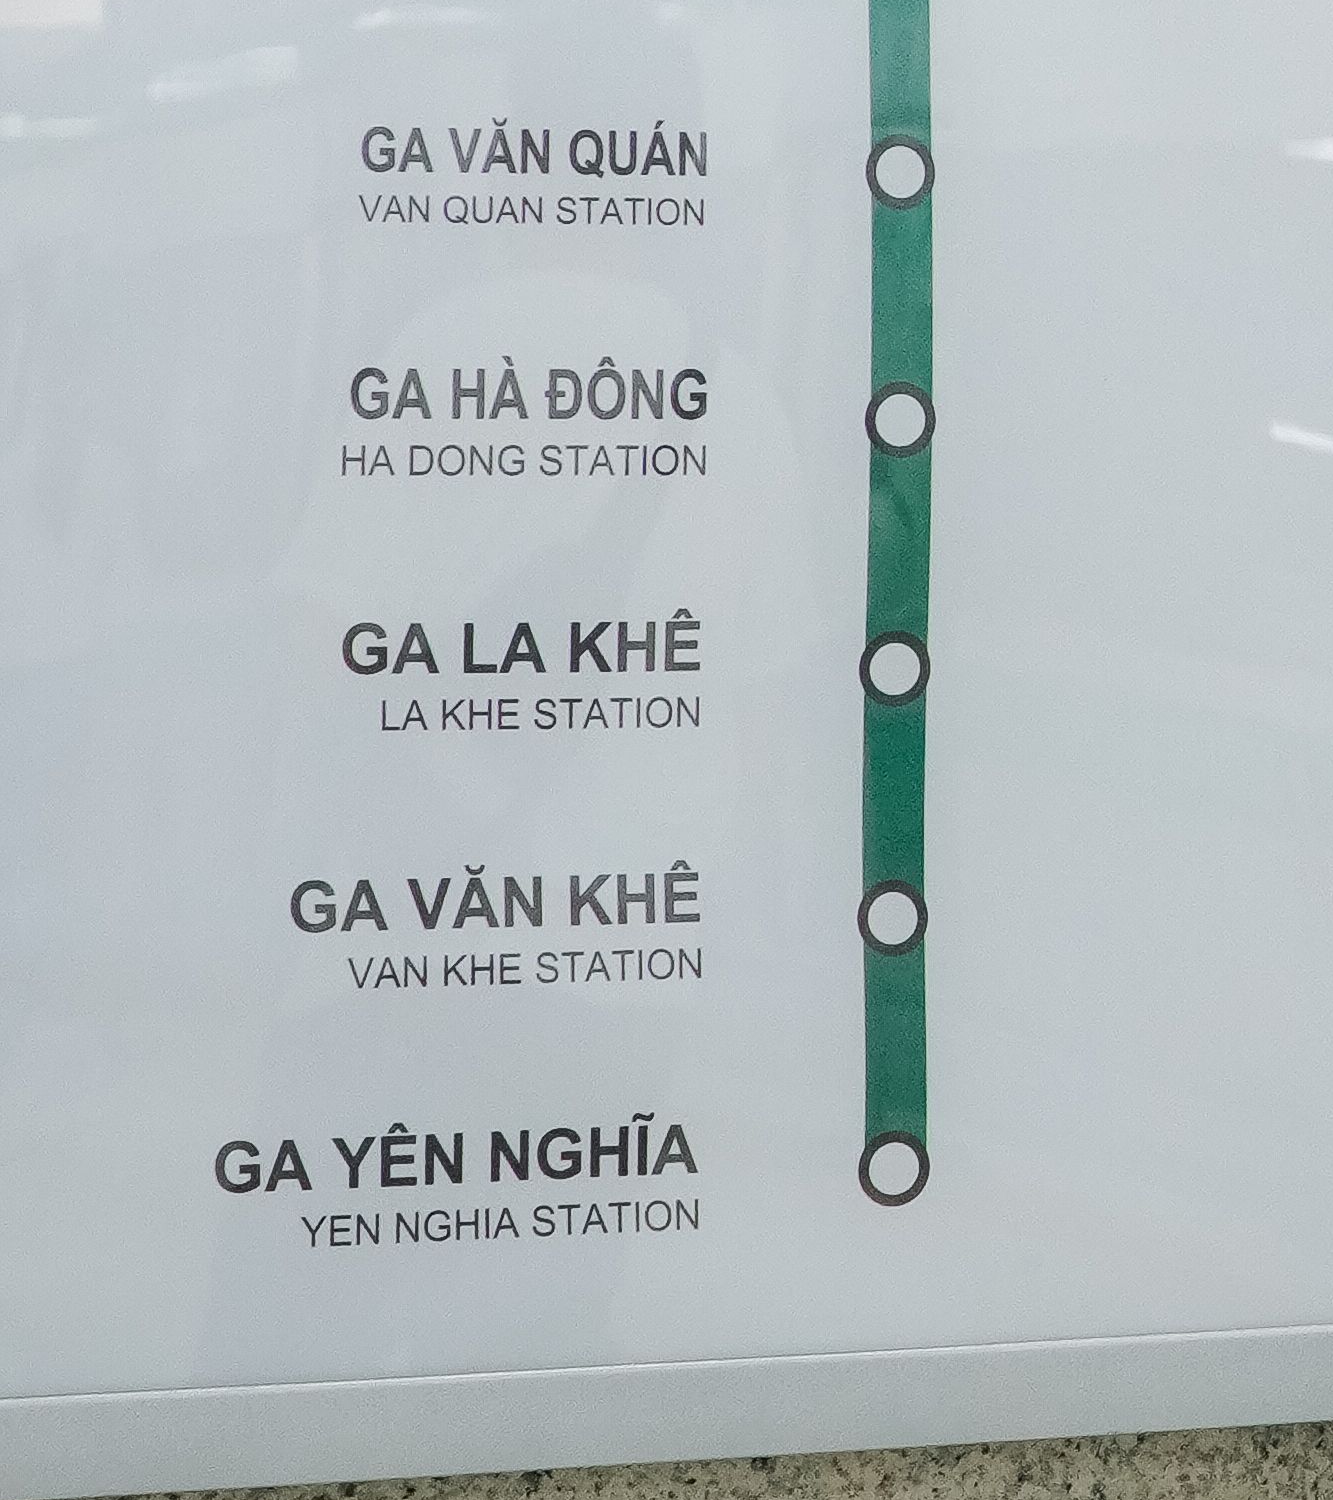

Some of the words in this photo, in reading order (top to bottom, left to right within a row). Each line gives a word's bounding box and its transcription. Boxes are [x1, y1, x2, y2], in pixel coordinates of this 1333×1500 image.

[362, 127, 433, 172] GA
[449, 118, 550, 174] VĂN
[569, 120, 706, 178] QUÁN
[359, 195, 429, 222] VAN
[444, 196, 542, 224] QUAN
[557, 197, 704, 225] STATION
[351, 368, 431, 419] GA
[452, 356, 528, 419] HÀ
[545, 357, 707, 420] ĐÔNG
[342, 445, 394, 475] HA
[409, 445, 524, 476] DONG
[540, 445, 706, 476] STATION
[343, 623, 439, 675] GA
[464, 623, 546, 673] LA
[570, 609, 700, 672] KHÊ
[382, 700, 427, 731] LA
[443, 699, 519, 730] KHE
[534, 697, 699, 729] STATION
[291, 880, 388, 933] GA
[407, 865, 542, 929] VĂN
[570, 860, 700, 925] KHÊ
[348, 956, 427, 988] VAN
[444, 953, 521, 986] KHE
[537, 948, 701, 983] STATION
[215, 1140, 312, 1193] GA
[332, 1123, 463, 1188] YÊN
[491, 1112, 698, 1182] NGHĨA
[301, 1214, 379, 1247] YEN
[396, 1208, 519, 1243] NGHIA
[533, 1199, 698, 1237] STATION
